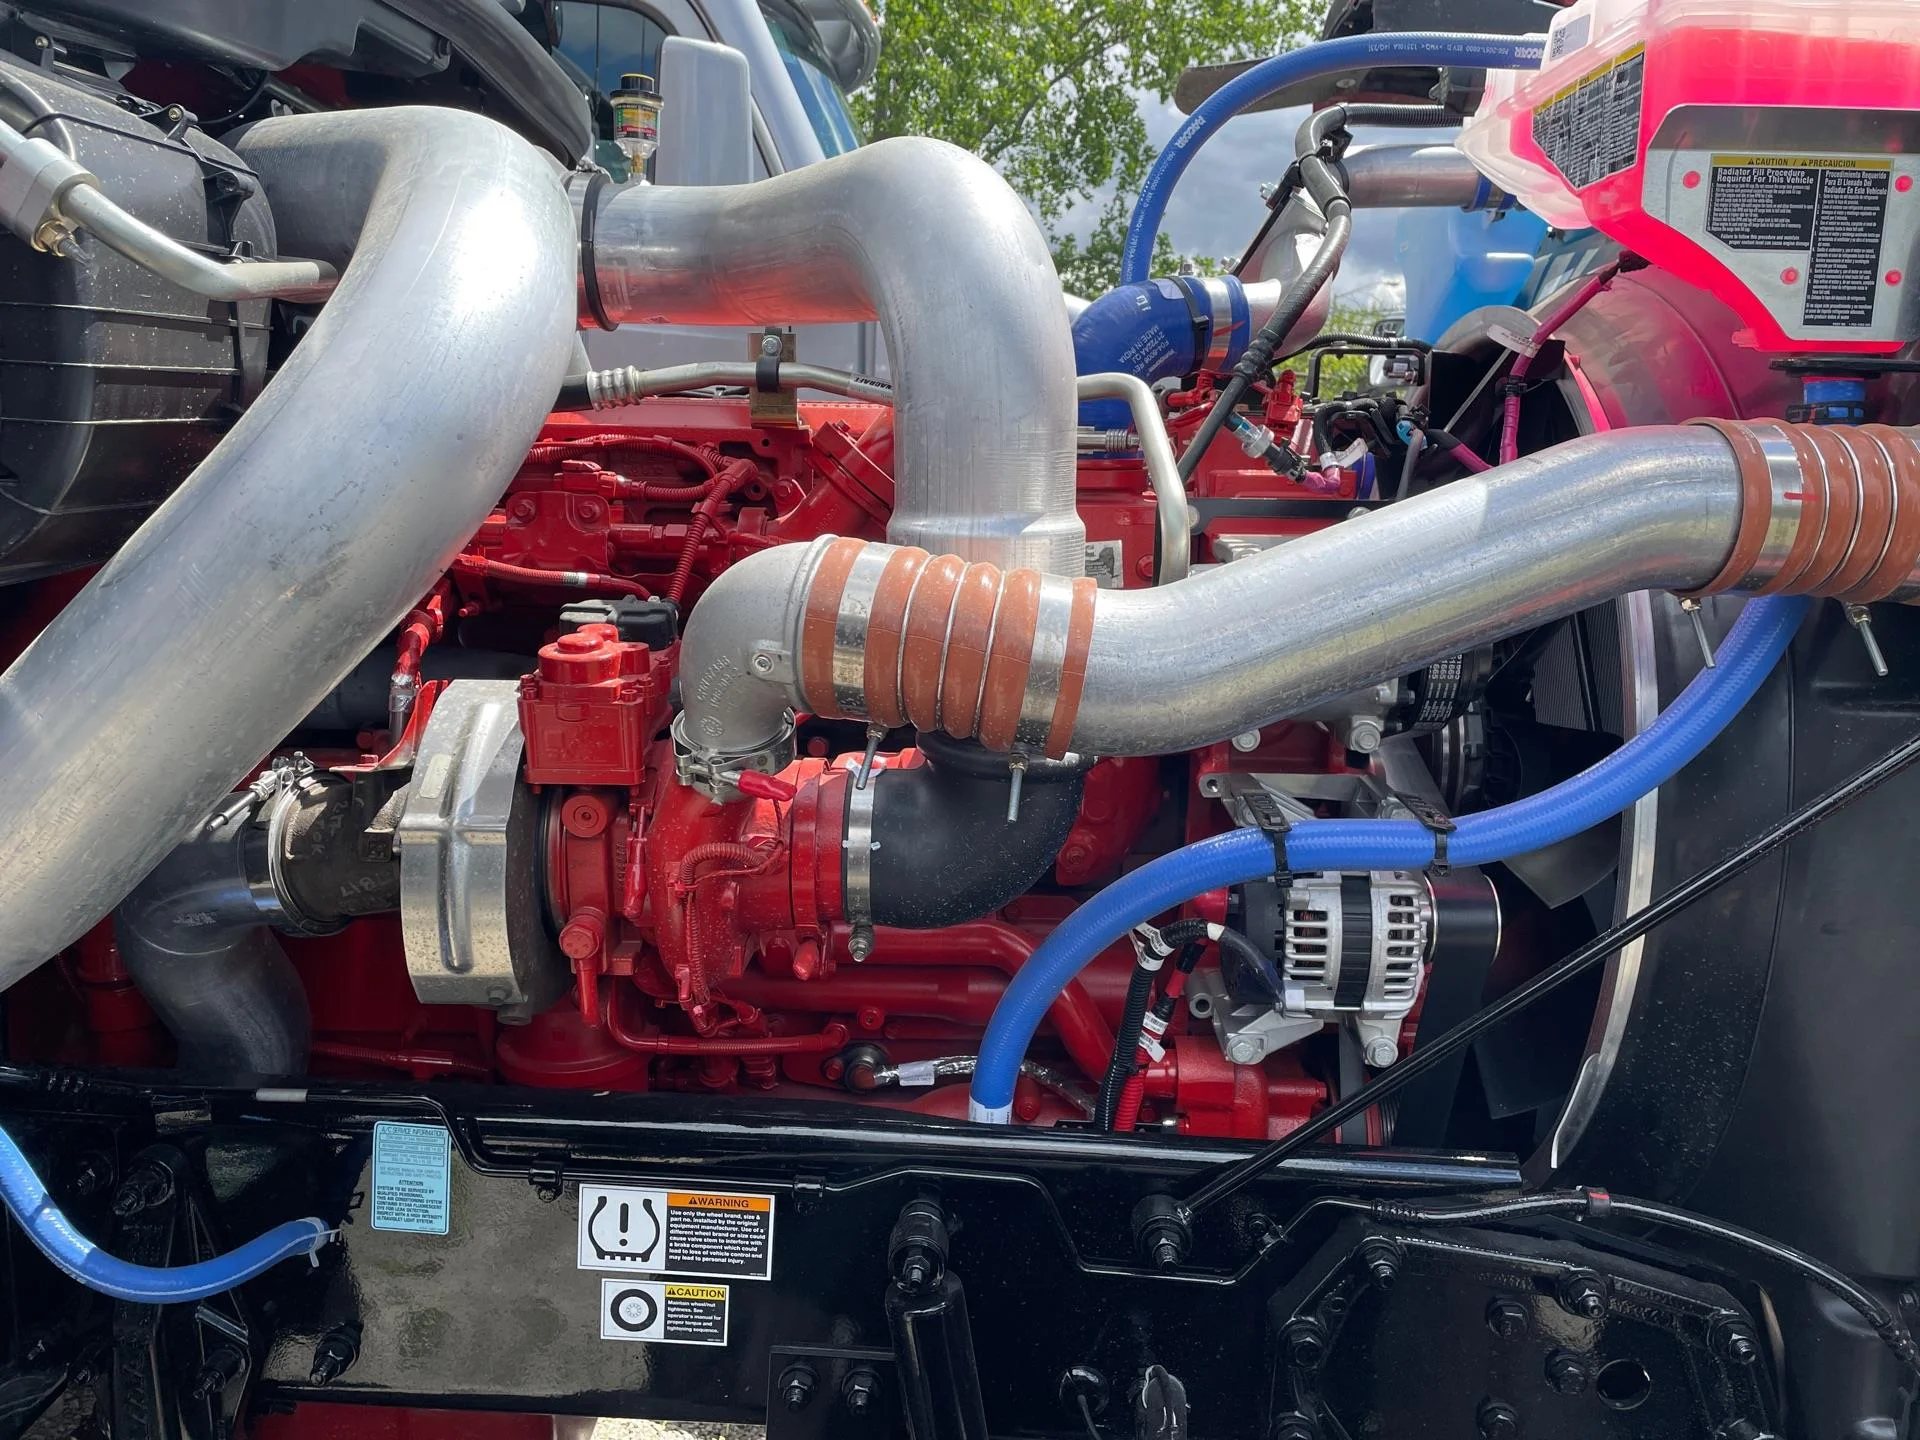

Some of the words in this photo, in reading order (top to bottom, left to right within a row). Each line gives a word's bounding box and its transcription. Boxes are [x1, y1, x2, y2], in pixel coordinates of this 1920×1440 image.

[1174, 116, 1206, 149] PACCAR
[1767, 169, 1805, 177] Procedure
[1717, 175, 1750, 183] Required
[698, 1198, 749, 1207] WARNING
[677, 1288, 724, 1298] CAUTION
